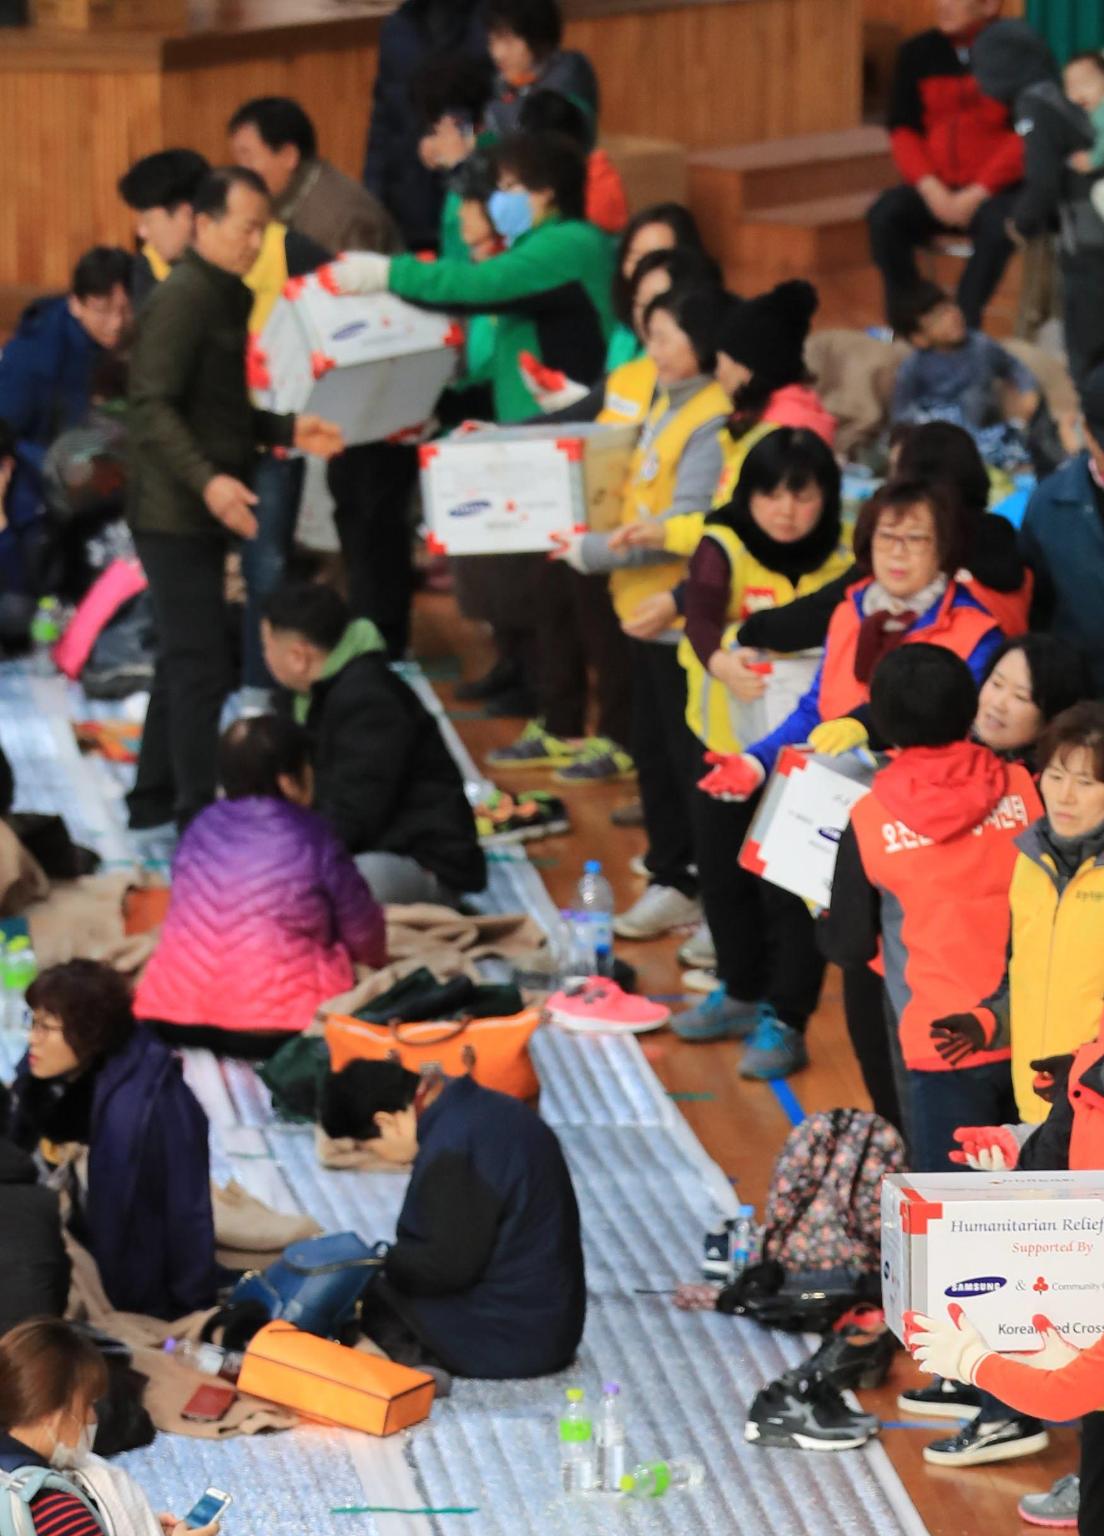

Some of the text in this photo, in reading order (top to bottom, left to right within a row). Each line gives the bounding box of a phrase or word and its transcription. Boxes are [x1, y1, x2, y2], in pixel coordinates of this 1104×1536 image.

[951, 1218, 1057, 1233] Humanitarian
[1011, 1242, 1094, 1257] Supported By
[951, 1281, 1001, 1292] SAMSUNG
[1015, 1279, 1026, 1291] &
[1051, 1282, 1100, 1293] Community
